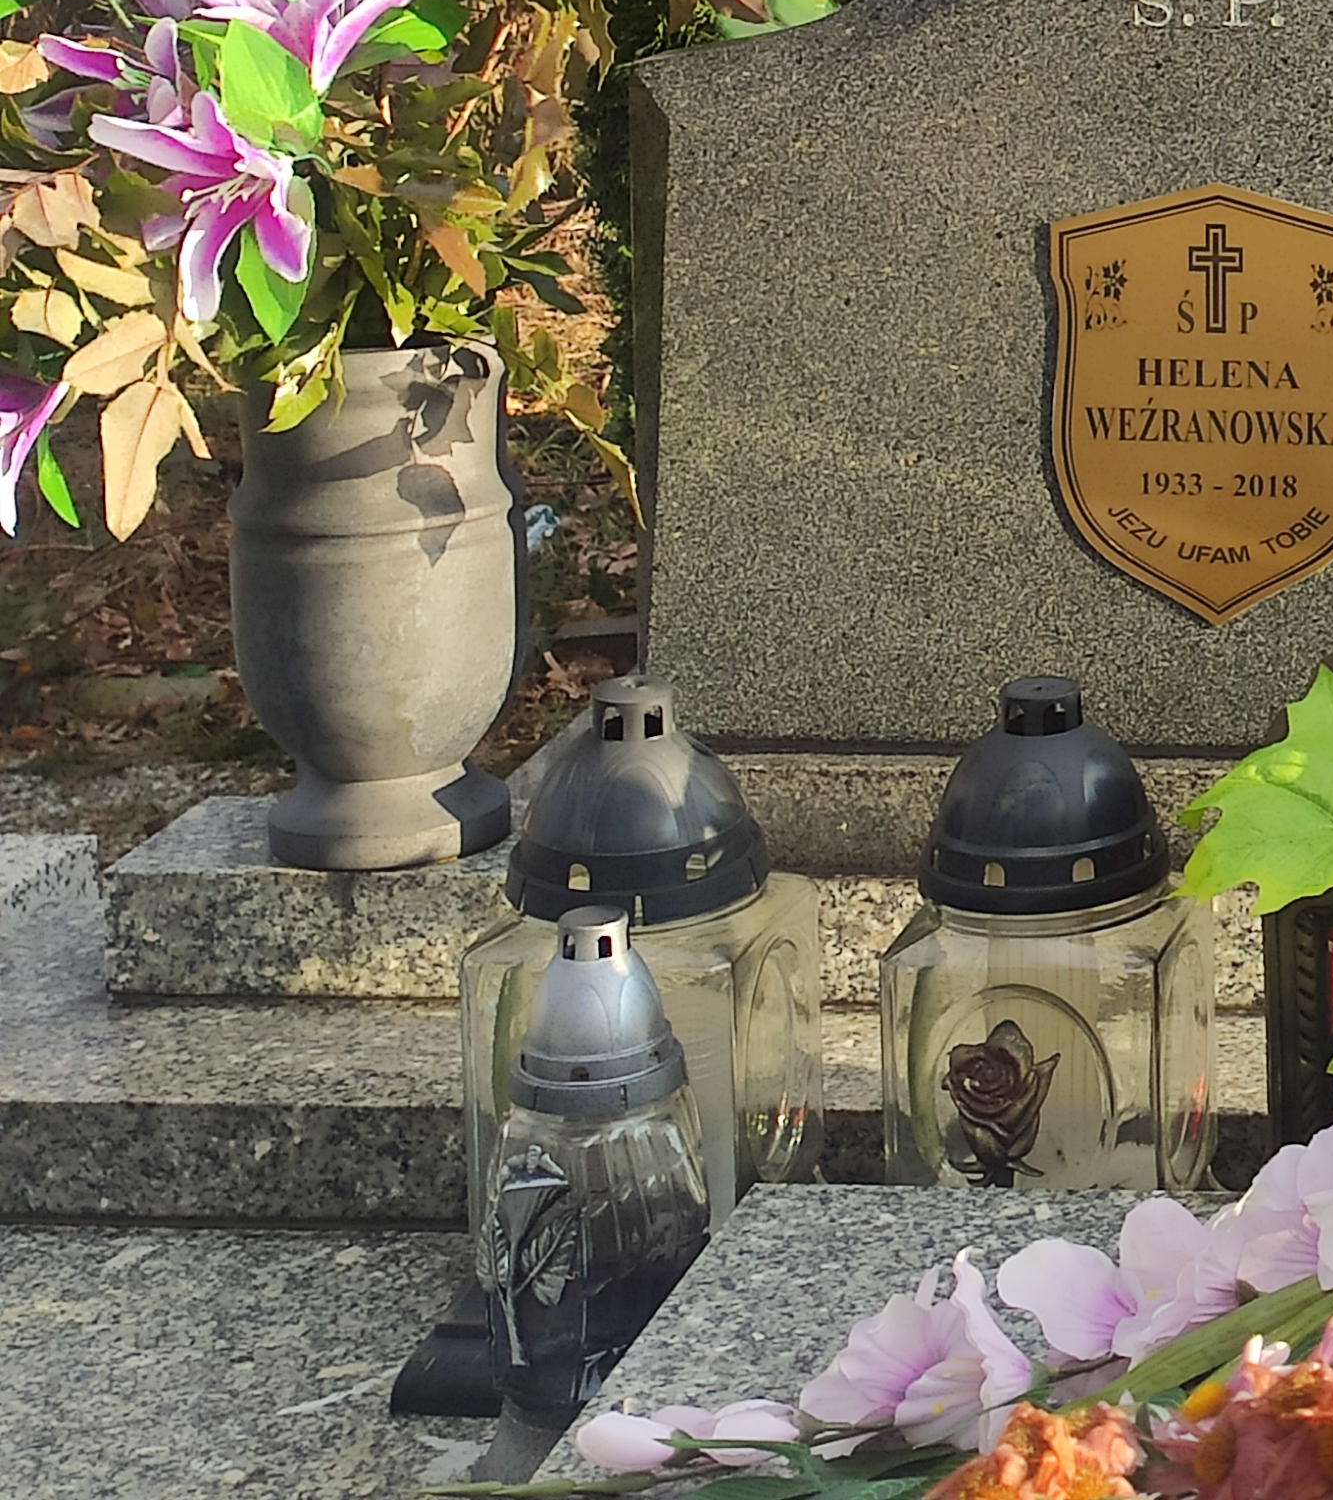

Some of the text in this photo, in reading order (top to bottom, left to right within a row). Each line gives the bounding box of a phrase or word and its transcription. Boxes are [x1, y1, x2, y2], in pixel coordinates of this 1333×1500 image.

[1177, 290, 1258, 334] Ś P
[1137, 358, 1300, 389] HELENA
[1141, 472, 1203, 495] 1933
[1233, 474, 1297, 498] 2018
[1107, 506, 1331, 564] JEZU UFAM TOBIE
